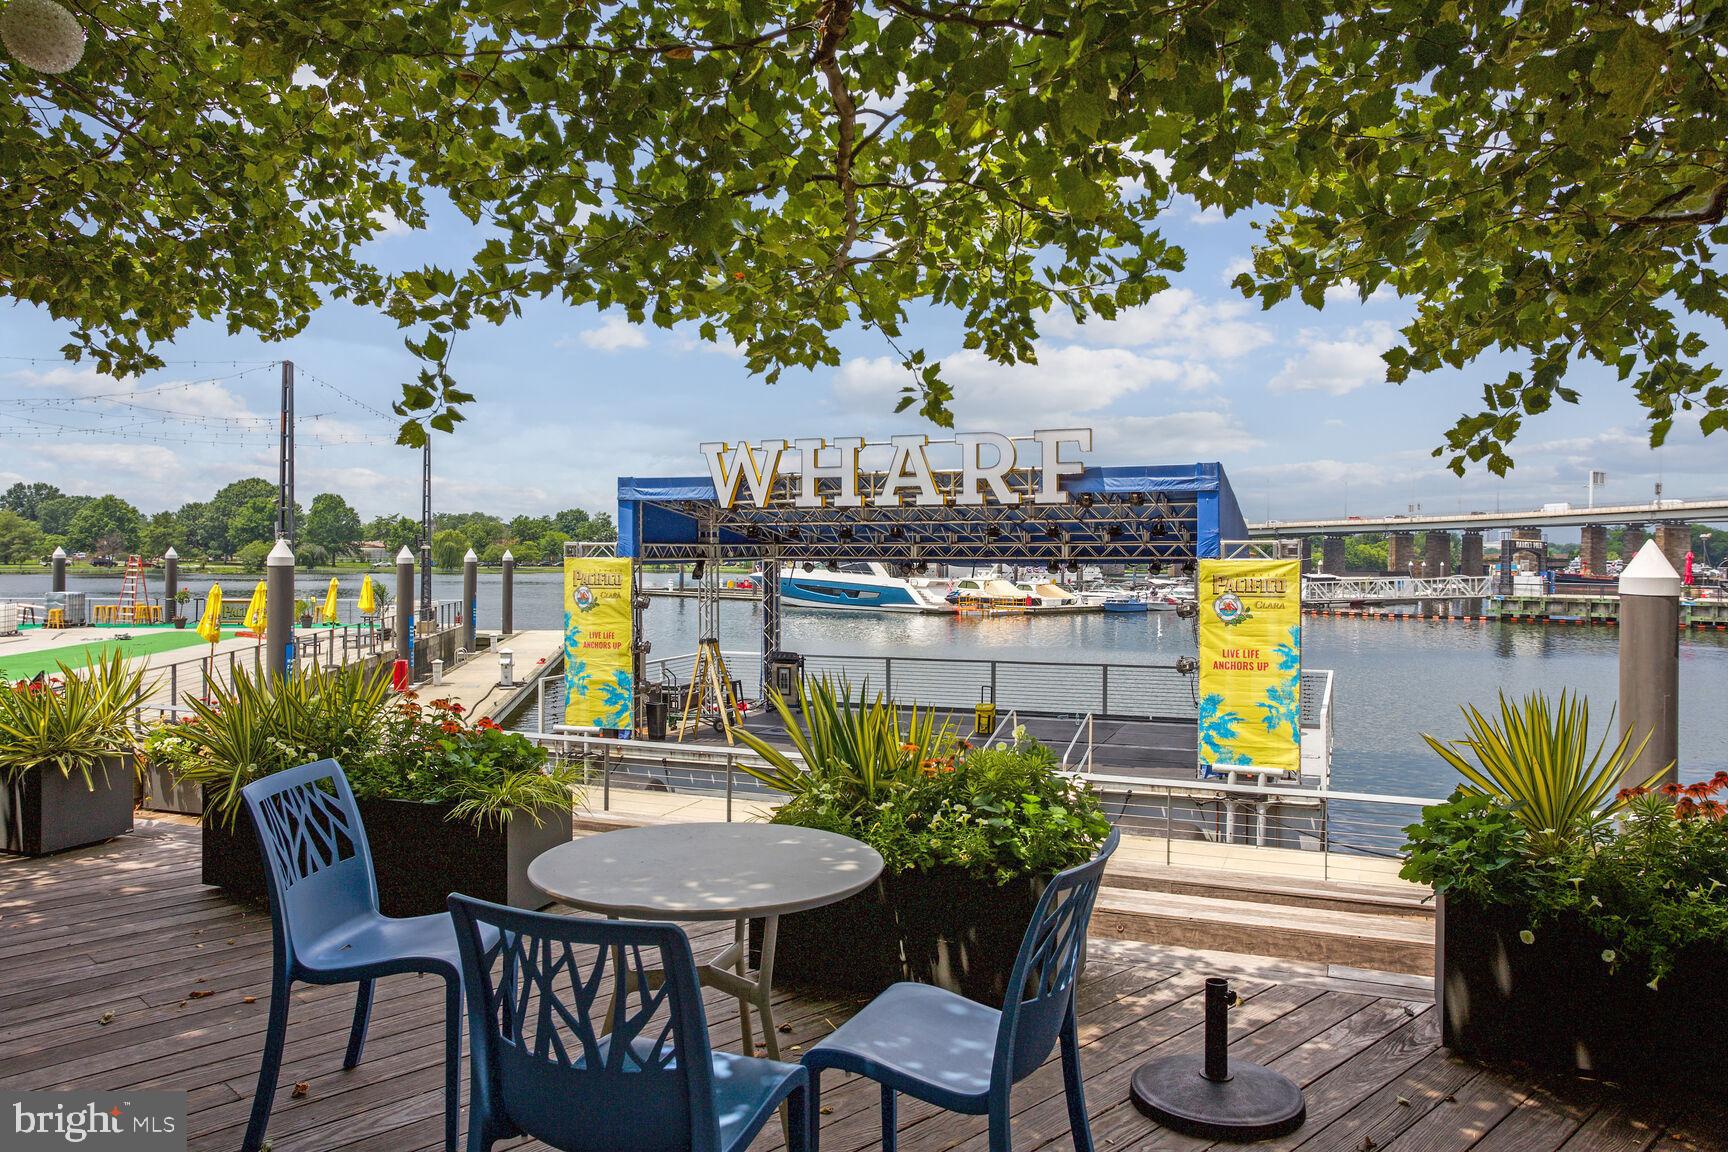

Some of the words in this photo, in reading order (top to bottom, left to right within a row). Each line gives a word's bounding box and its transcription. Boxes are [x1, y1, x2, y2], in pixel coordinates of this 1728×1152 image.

[700, 428, 1092, 508] WHARF
[589, 631, 602, 640] LIVE
[603, 632, 615, 640] LIFE
[583, 641, 611, 650] ANCHORS
[612, 641, 622, 650] UP
[1222, 649, 1240, 659] LIVE
[1243, 649, 1260, 659] LIFE
[1212, 660, 1254, 671] ANCHORS
[1257, 661, 1269, 671] UP
